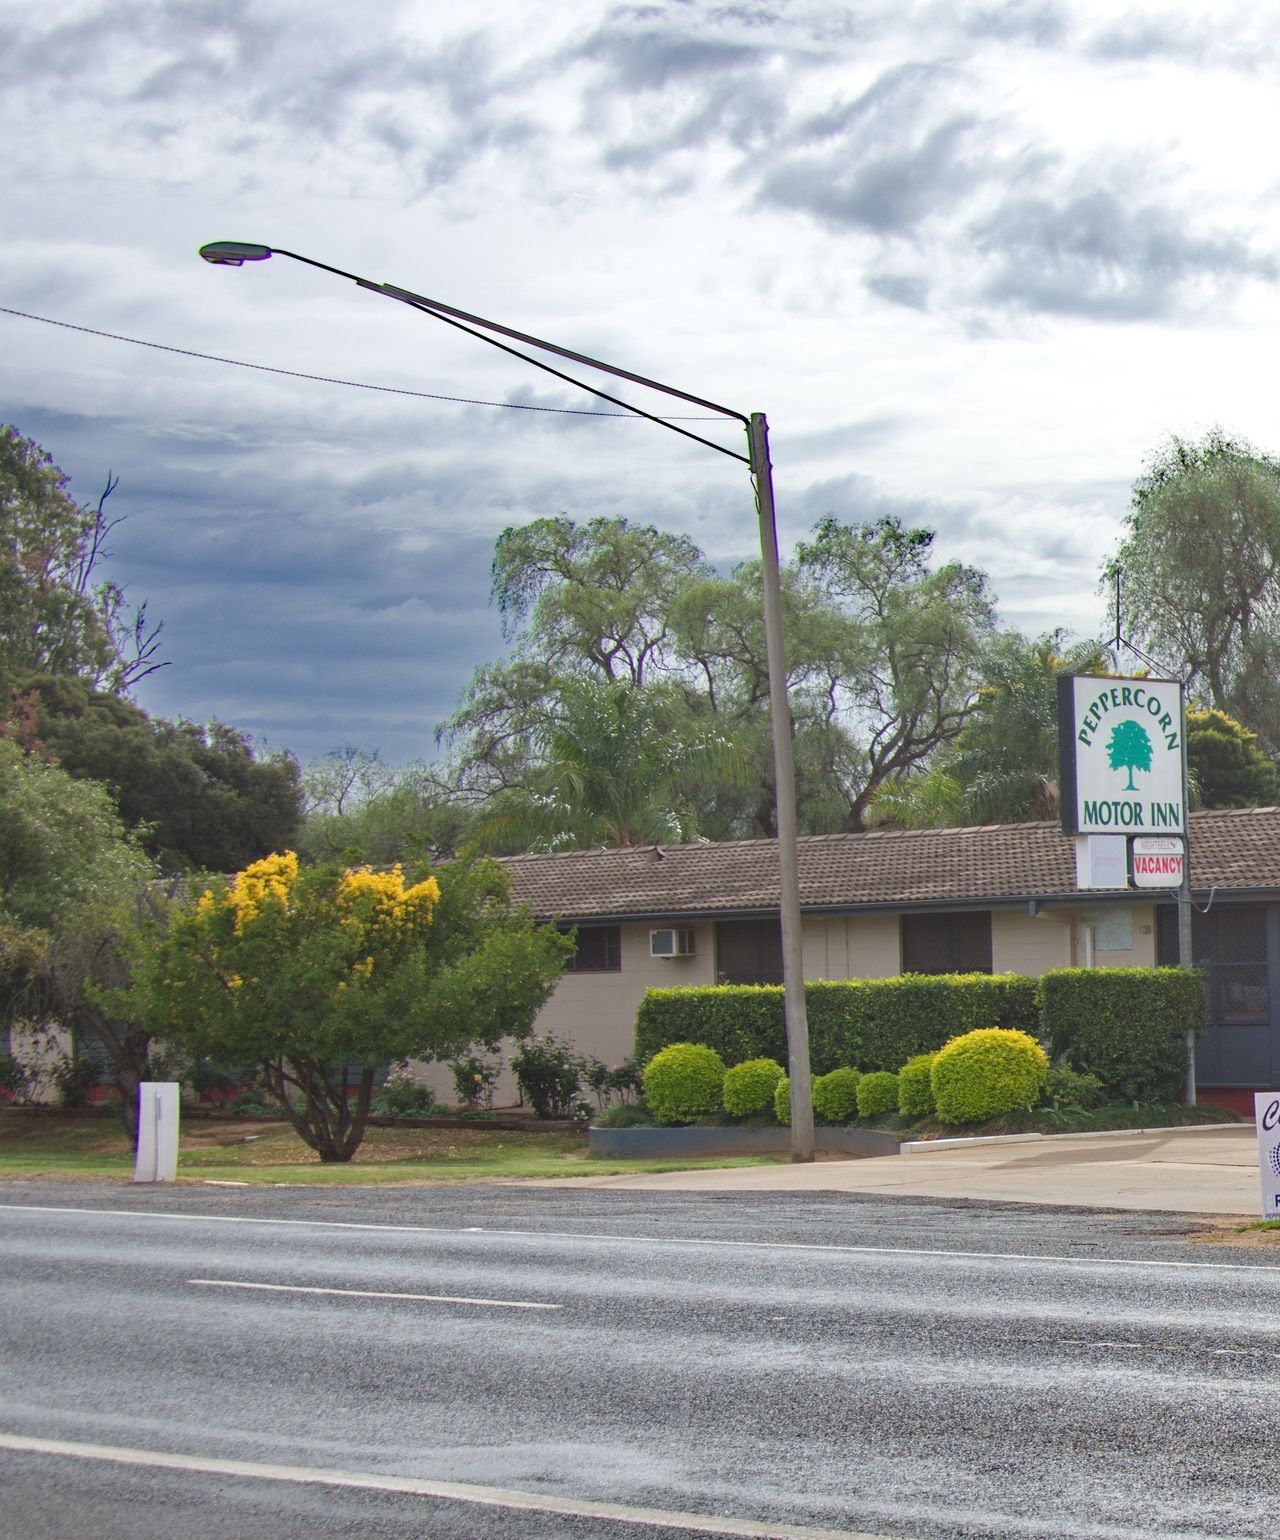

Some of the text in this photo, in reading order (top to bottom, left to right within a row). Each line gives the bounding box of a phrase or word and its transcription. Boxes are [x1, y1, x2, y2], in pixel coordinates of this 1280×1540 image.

[1078, 687, 1180, 751] PEPPERCORN
[1083, 801, 1180, 827] MOTOR INN
[1134, 857, 1182, 874] VACANCY
